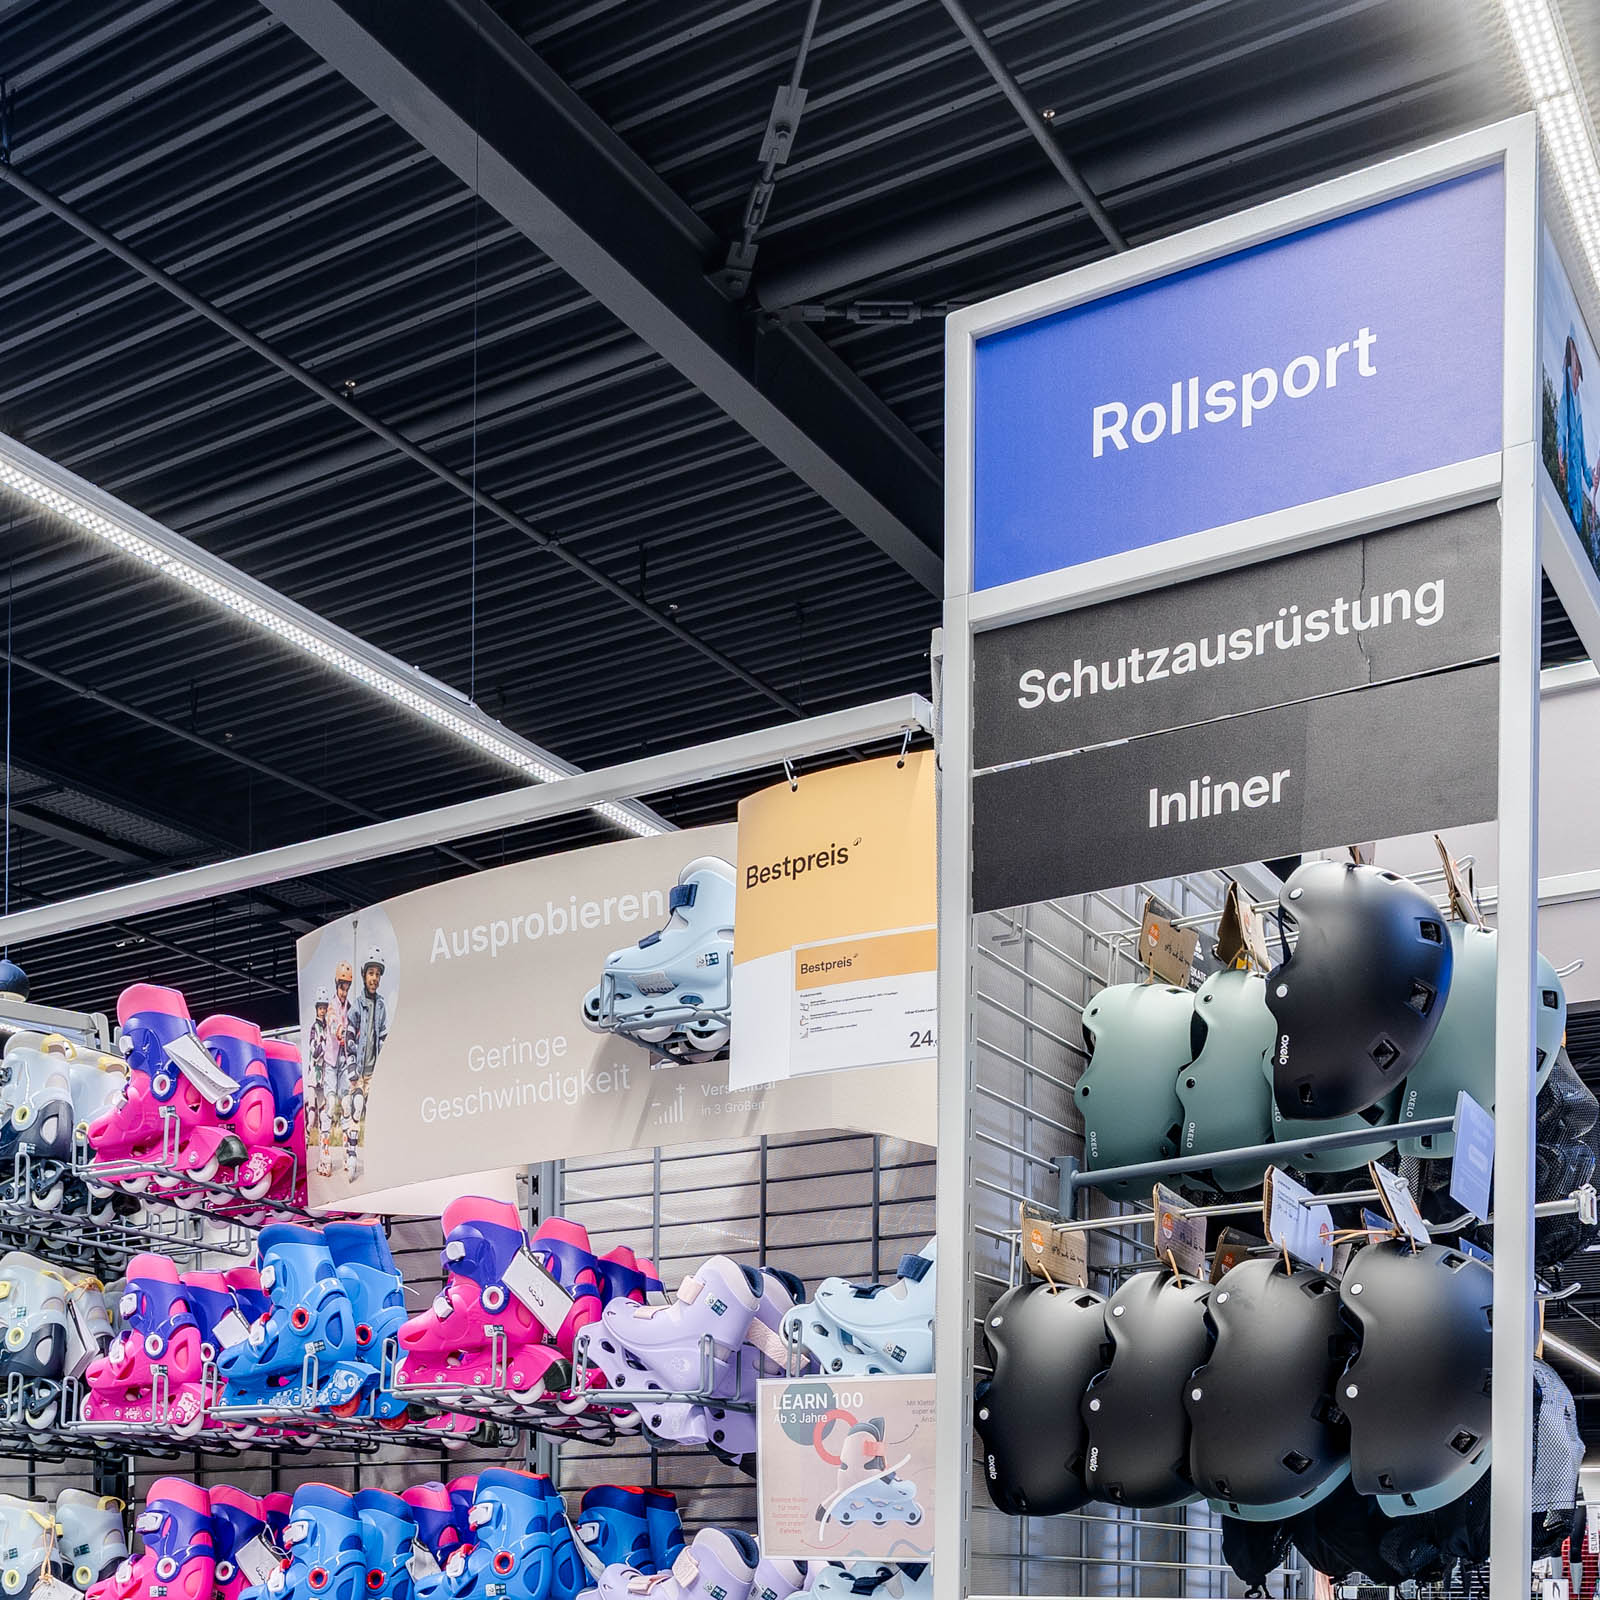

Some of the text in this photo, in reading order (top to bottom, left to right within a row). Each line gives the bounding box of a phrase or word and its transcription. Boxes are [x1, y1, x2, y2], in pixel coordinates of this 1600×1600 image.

[1091, 326, 1378, 459] Rollsport
[1017, 577, 1447, 711] Schutzausrüstung
[1148, 766, 1291, 829] Inliner
[745, 842, 850, 890] Bestpreis
[428, 888, 663, 965] Ausprobieren
[800, 956, 853, 975] Bestpreis
[466, 1032, 568, 1074] Geringe
[419, 1062, 631, 1124] Geschwindigkeit
[1405, 1090, 1418, 1118] OXELO
[1089, 1130, 1098, 1158] OXELO
[1186, 1121, 1196, 1149] OXELO
[772, 1391, 864, 1410] LEARN 100
[772, 1412, 828, 1424] Ab 3 Jahre
[1590, 1532, 1598, 1552] SLIM
